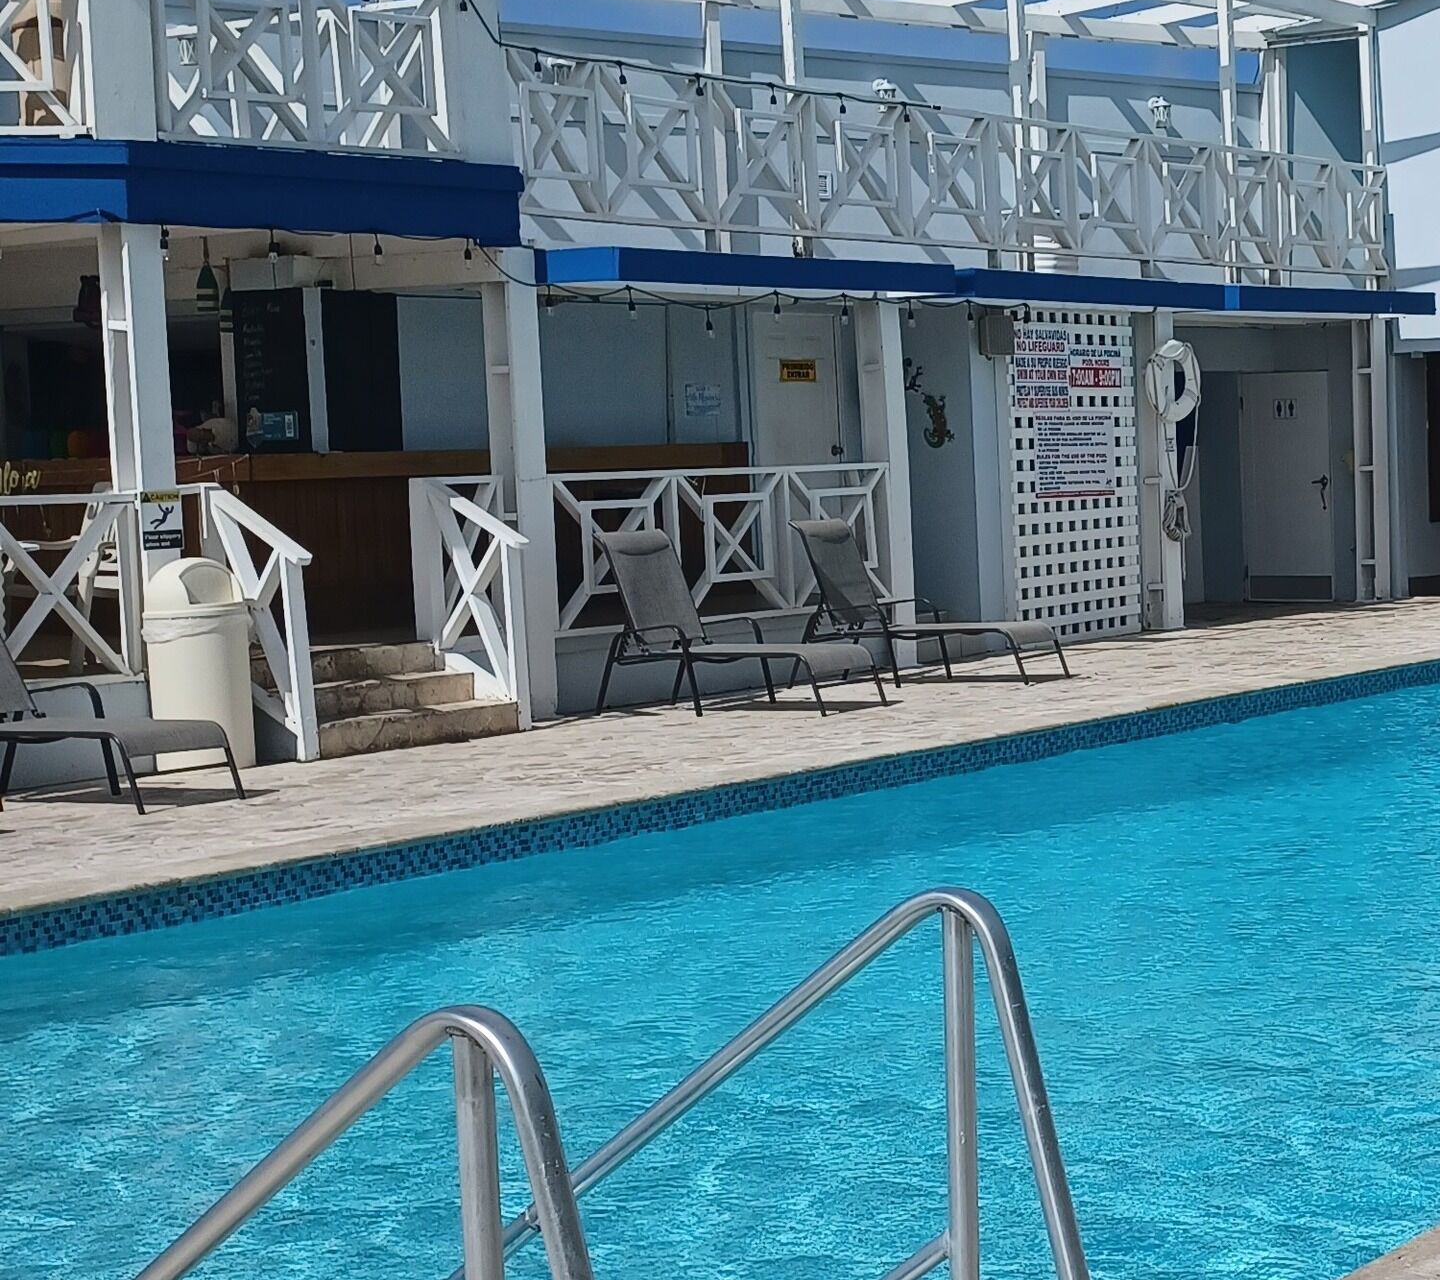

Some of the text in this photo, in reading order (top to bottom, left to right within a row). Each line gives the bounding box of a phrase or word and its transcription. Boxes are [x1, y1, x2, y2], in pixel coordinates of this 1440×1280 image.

[1023, 328, 1034, 340] HAY
[1035, 328, 1067, 341] SALVAVIDAS
[1016, 340, 1065, 353] NO LIFEGUARD
